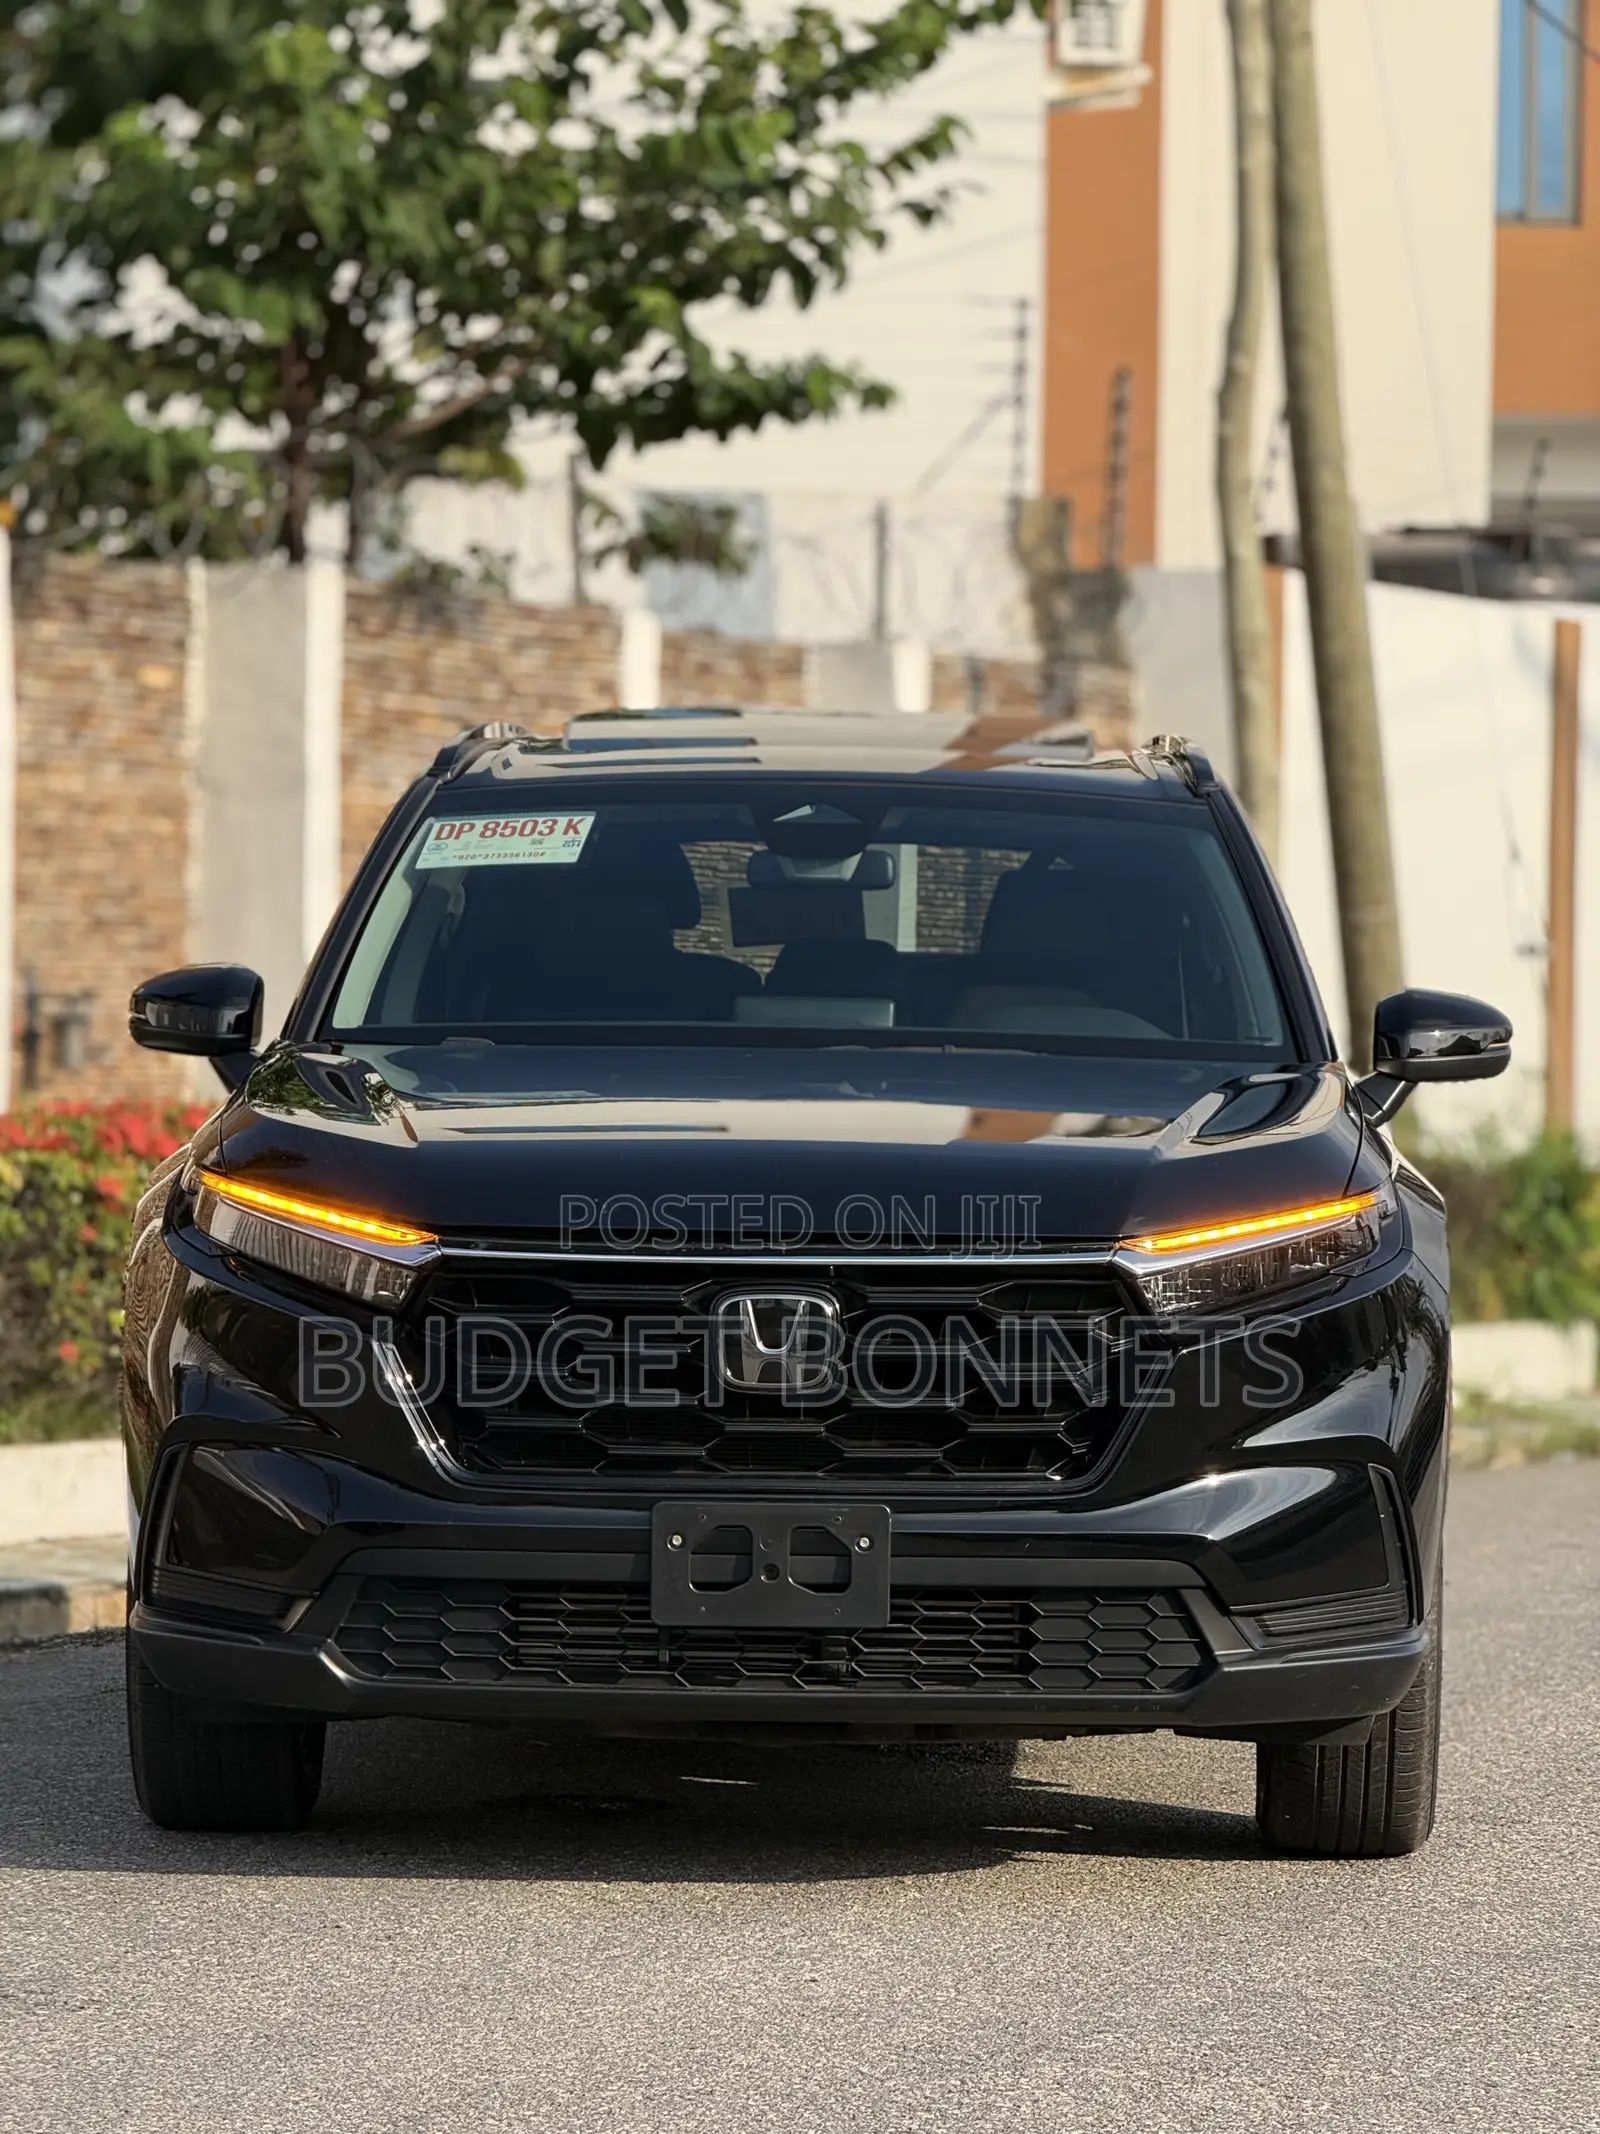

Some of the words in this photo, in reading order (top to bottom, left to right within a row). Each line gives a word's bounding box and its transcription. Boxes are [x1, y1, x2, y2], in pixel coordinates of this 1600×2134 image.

[433, 821, 476, 842] DP
[478, 818, 558, 839] 8503
[562, 817, 587, 836] K
